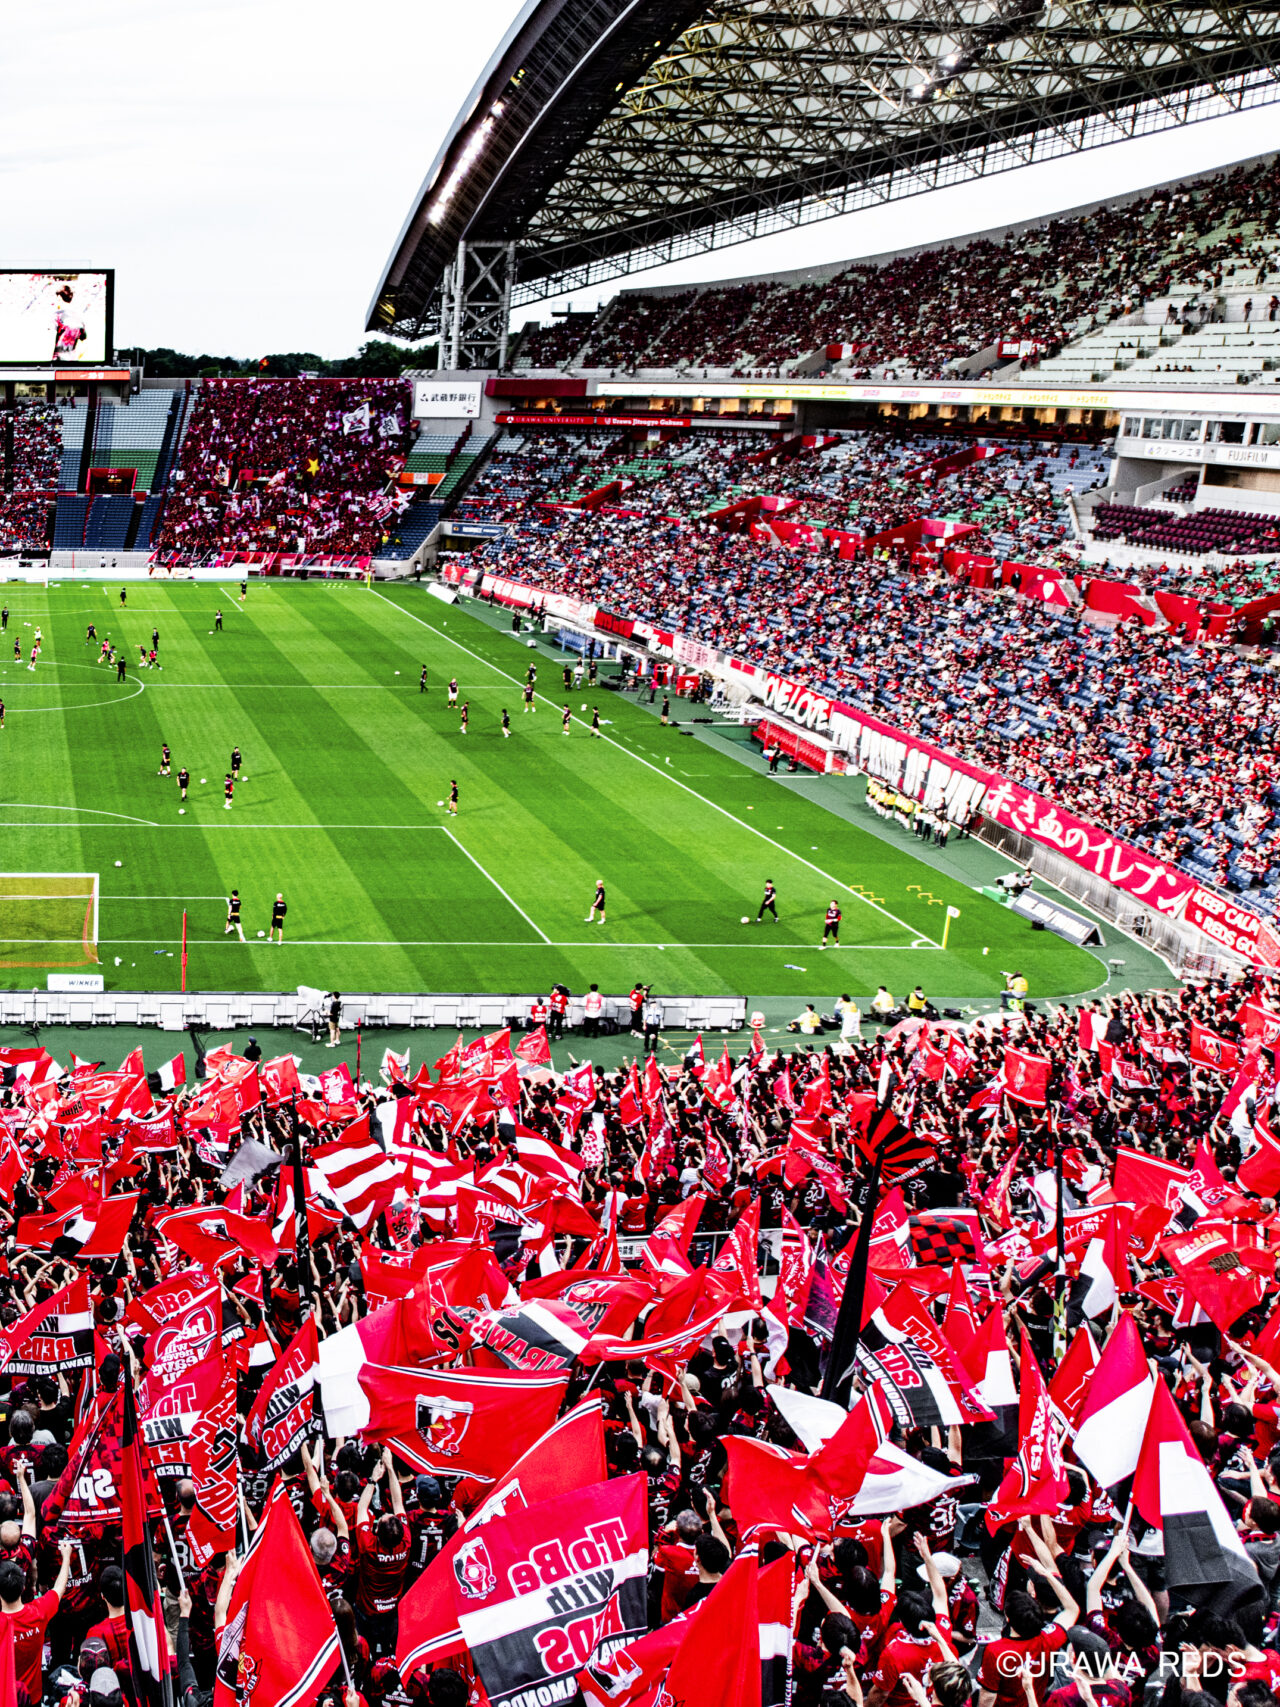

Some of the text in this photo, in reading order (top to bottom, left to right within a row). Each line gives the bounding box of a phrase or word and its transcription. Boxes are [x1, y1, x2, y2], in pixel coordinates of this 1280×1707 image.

[431, 393, 476, 402] 武蔵野銀行
[1228, 450, 1268, 463] FUJIFILM
[987, 782, 1193, 920] 赤き血のイレブン
[1192, 888, 1261, 936] KEEP CALM
[1202, 916, 1236, 945] REDS
[874, 1343, 923, 1388] EDS
[377, 1551, 407, 1563] POLUS
